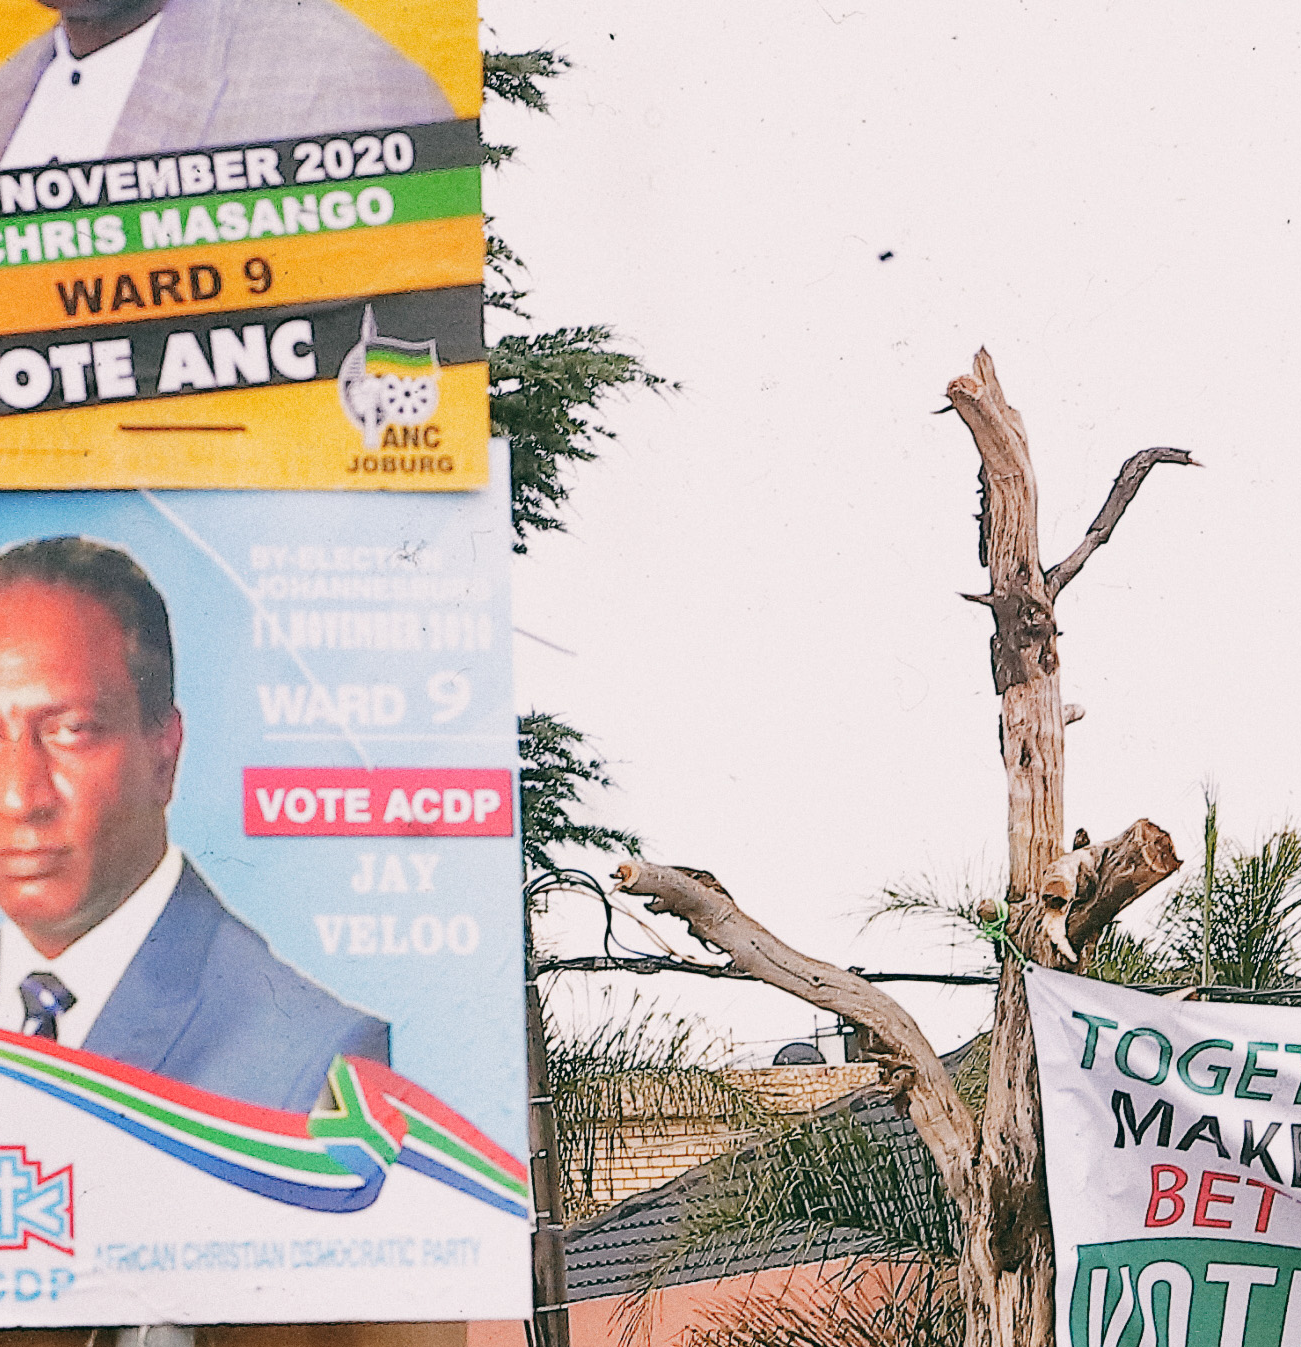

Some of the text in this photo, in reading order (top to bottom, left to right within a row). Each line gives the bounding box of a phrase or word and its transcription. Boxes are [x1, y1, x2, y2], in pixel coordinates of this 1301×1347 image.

[293, 131, 414, 184] 2020
[141, 186, 395, 249] MASANGO
[56, 257, 274, 316] WARD 9
[158, 318, 318, 395] ANC
[380, 424, 441, 450] ANC
[345, 452, 454, 474] JOBURG
[257, 669, 473, 726] WARD 9
[255, 786, 501, 824] VOTE ACDP
[351, 852, 441, 895] JAY
[315, 914, 481, 957] VELOO
[422, 1236, 482, 1268] PARTY
